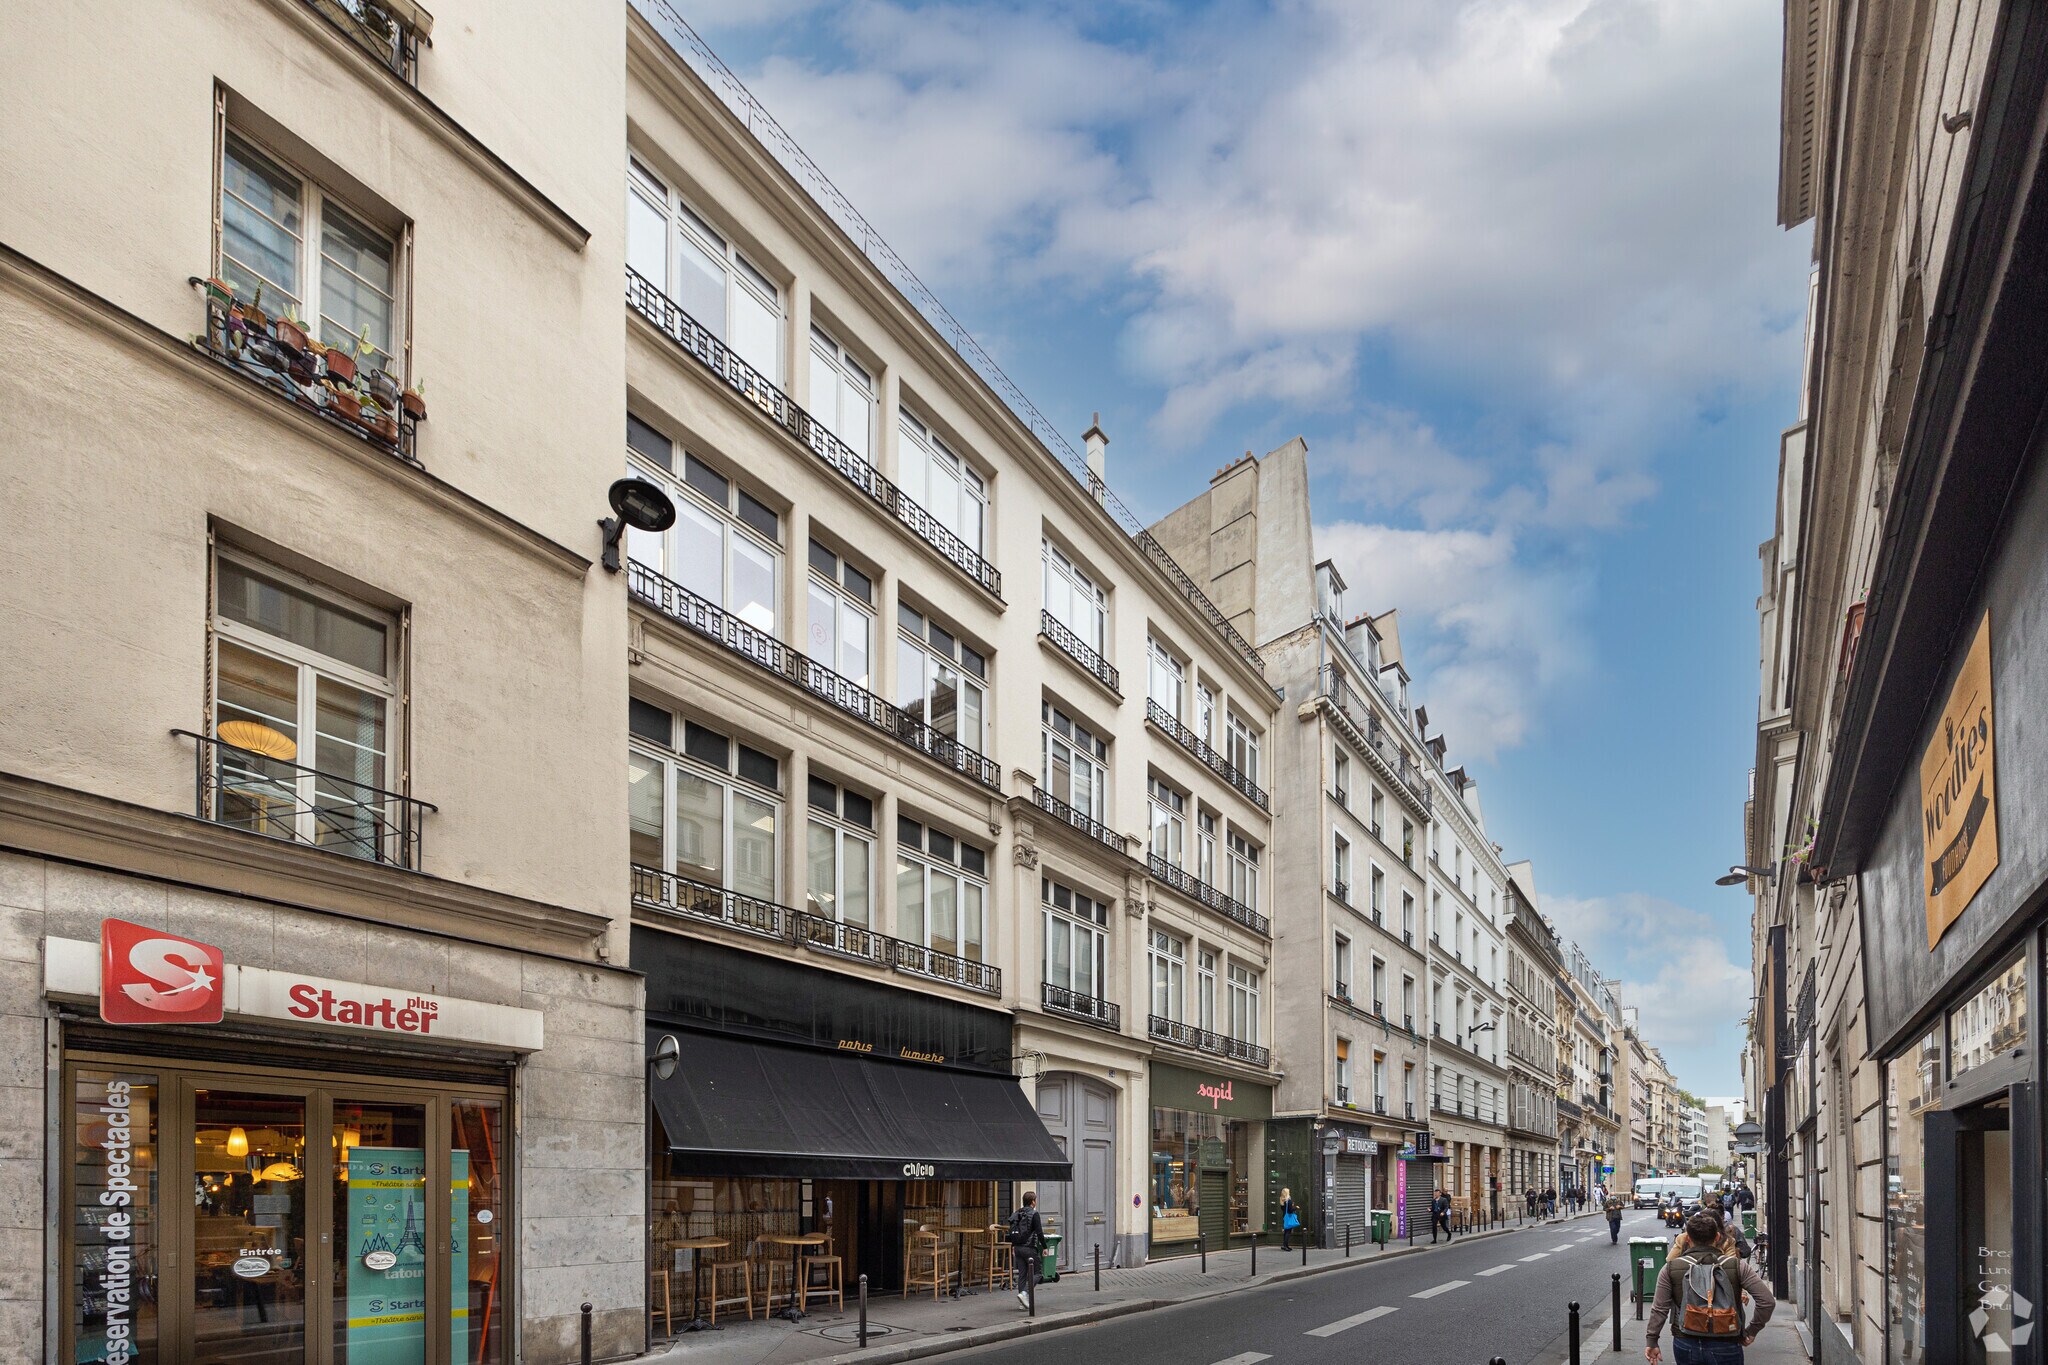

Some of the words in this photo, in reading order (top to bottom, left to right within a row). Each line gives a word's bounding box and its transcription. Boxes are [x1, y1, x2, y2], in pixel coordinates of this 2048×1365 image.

[1925, 705, 1988, 848] Woodies
[288, 984, 438, 1033] Starter
[407, 997, 438, 1010] plus
[1197, 1081, 1233, 1109] sapid
[100, 1081, 137, 1206] Spectacles
[1347, 1139, 1377, 1153] RETOUCHES
[100, 1212, 130, 1239] de
[240, 1247, 282, 1256] Entrée
